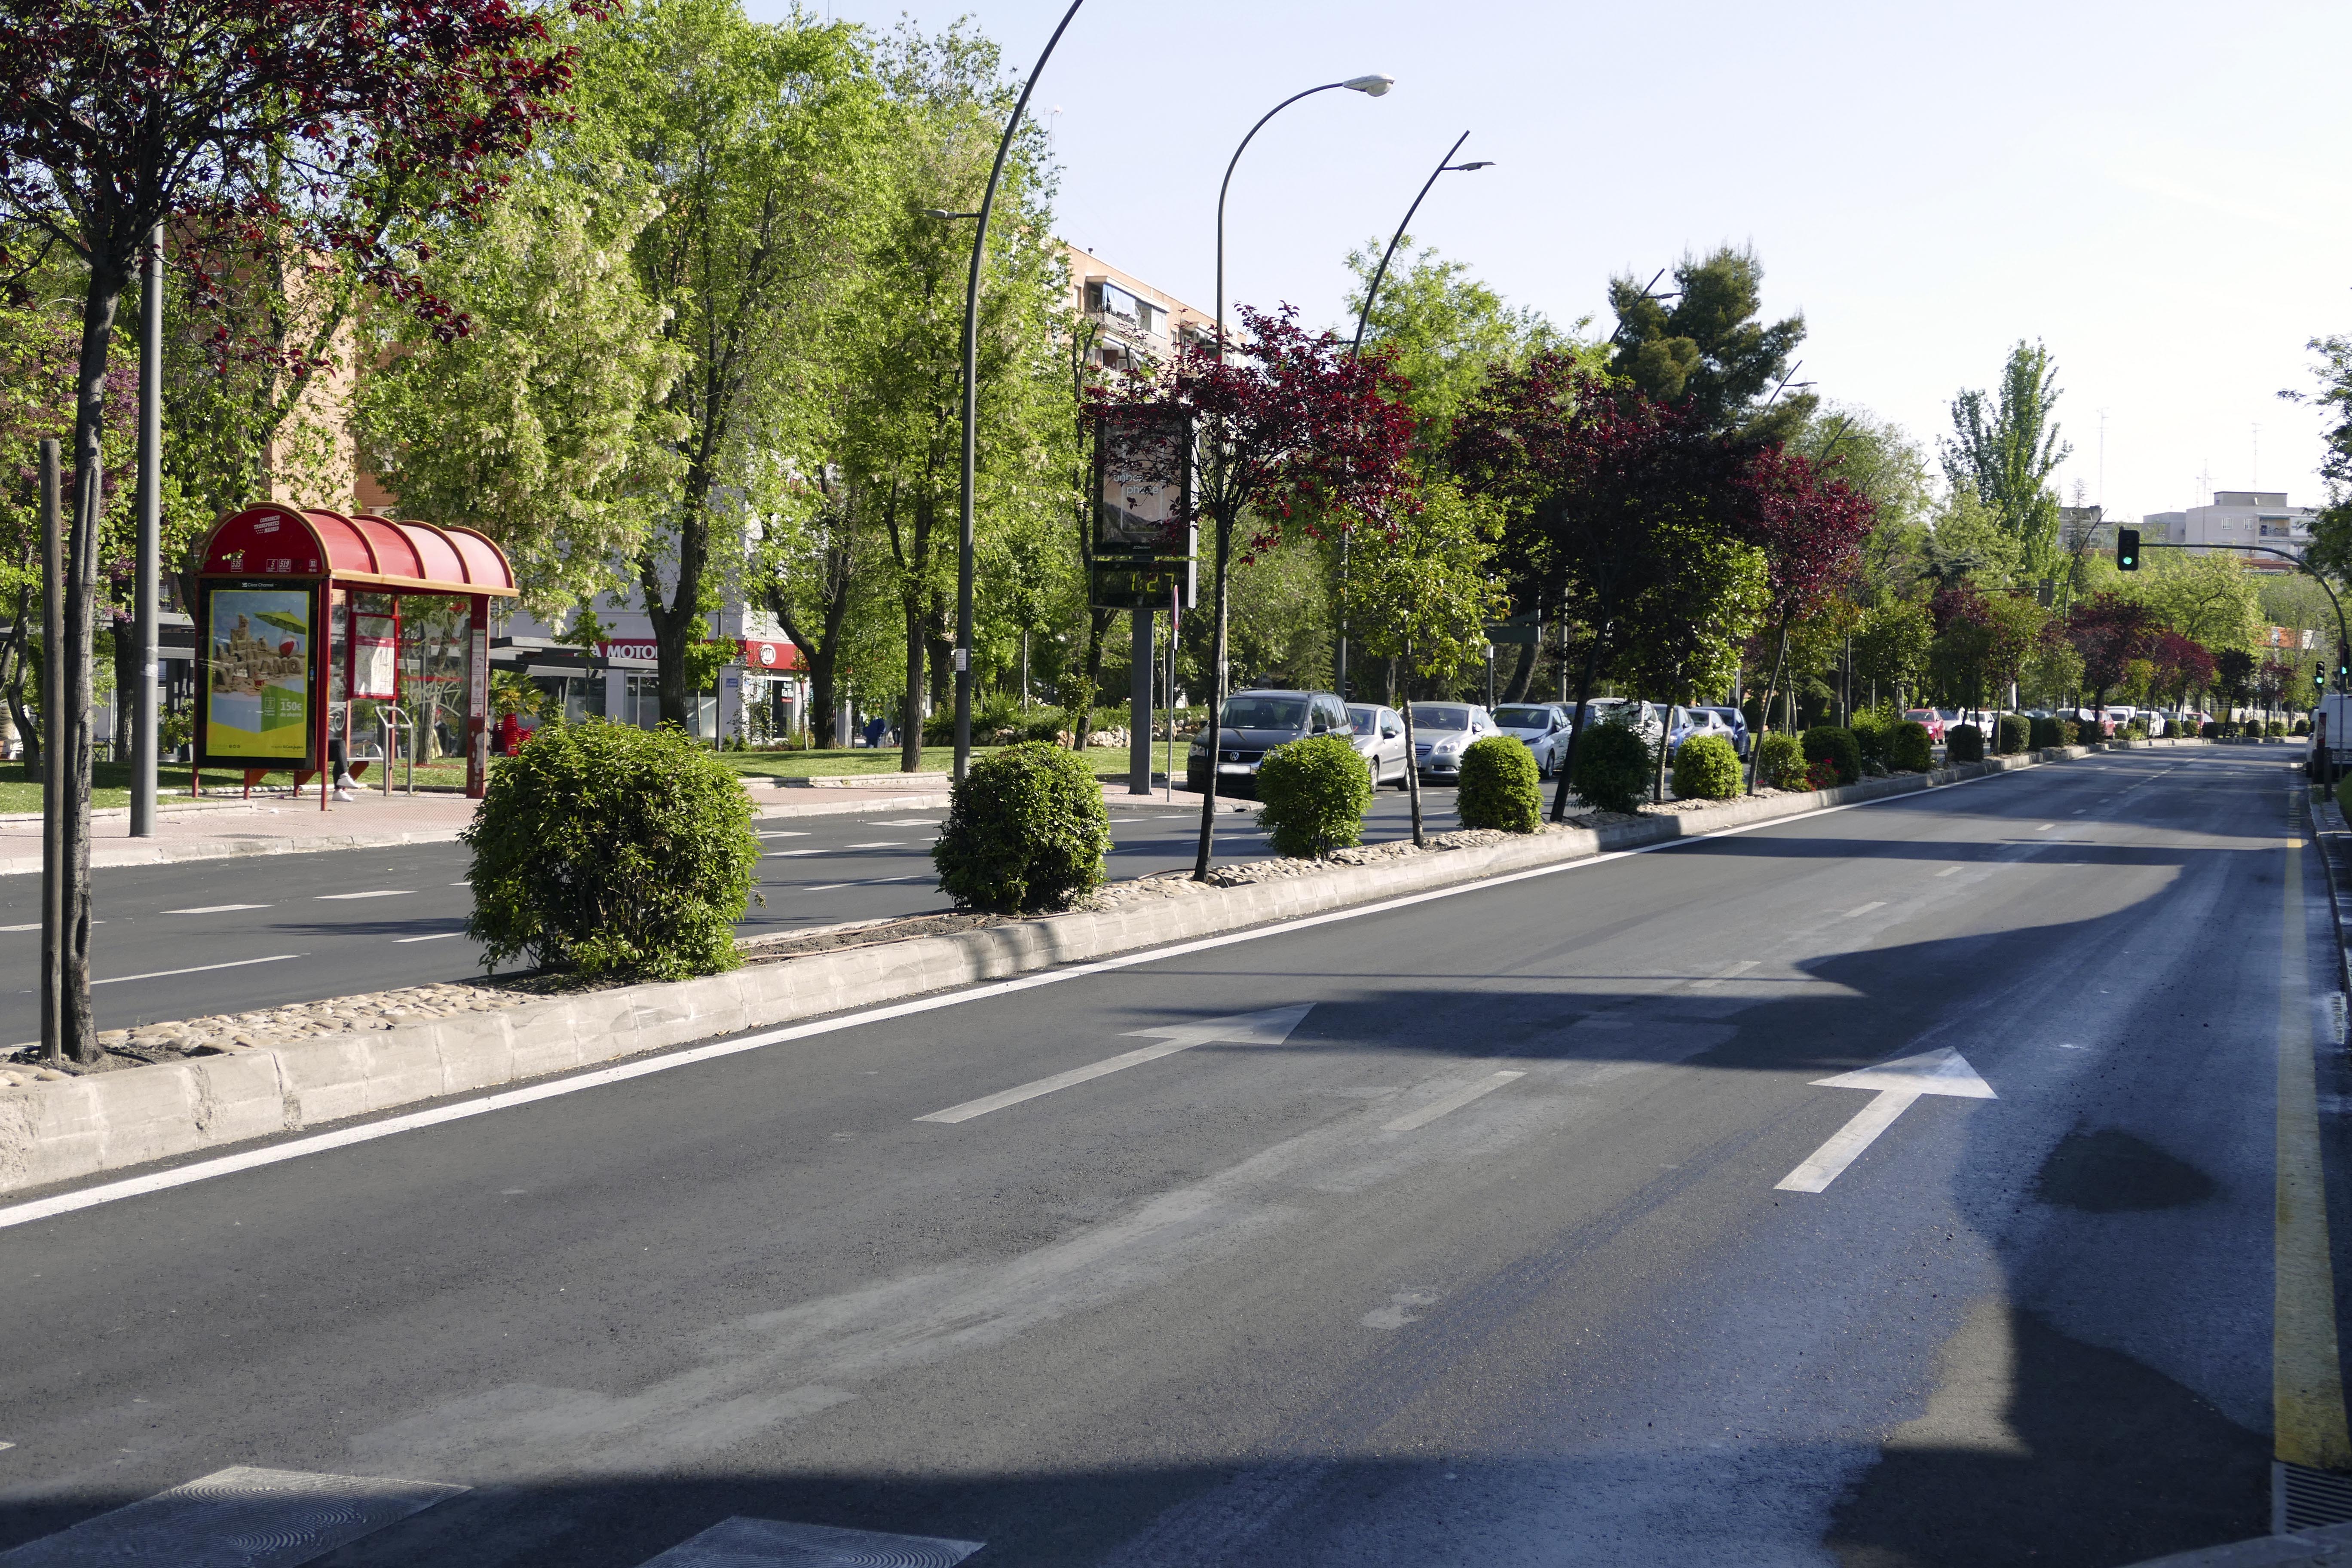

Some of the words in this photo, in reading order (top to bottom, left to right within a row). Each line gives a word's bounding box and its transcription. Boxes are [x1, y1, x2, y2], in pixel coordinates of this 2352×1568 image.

[1126, 486, 1159, 496] phoe
[260, 515, 280, 523] CONSORCIO
[254, 521, 279, 530] TRANSPORTES
[606, 645, 658, 659] MOTO
[280, 701, 302, 711] 150€
